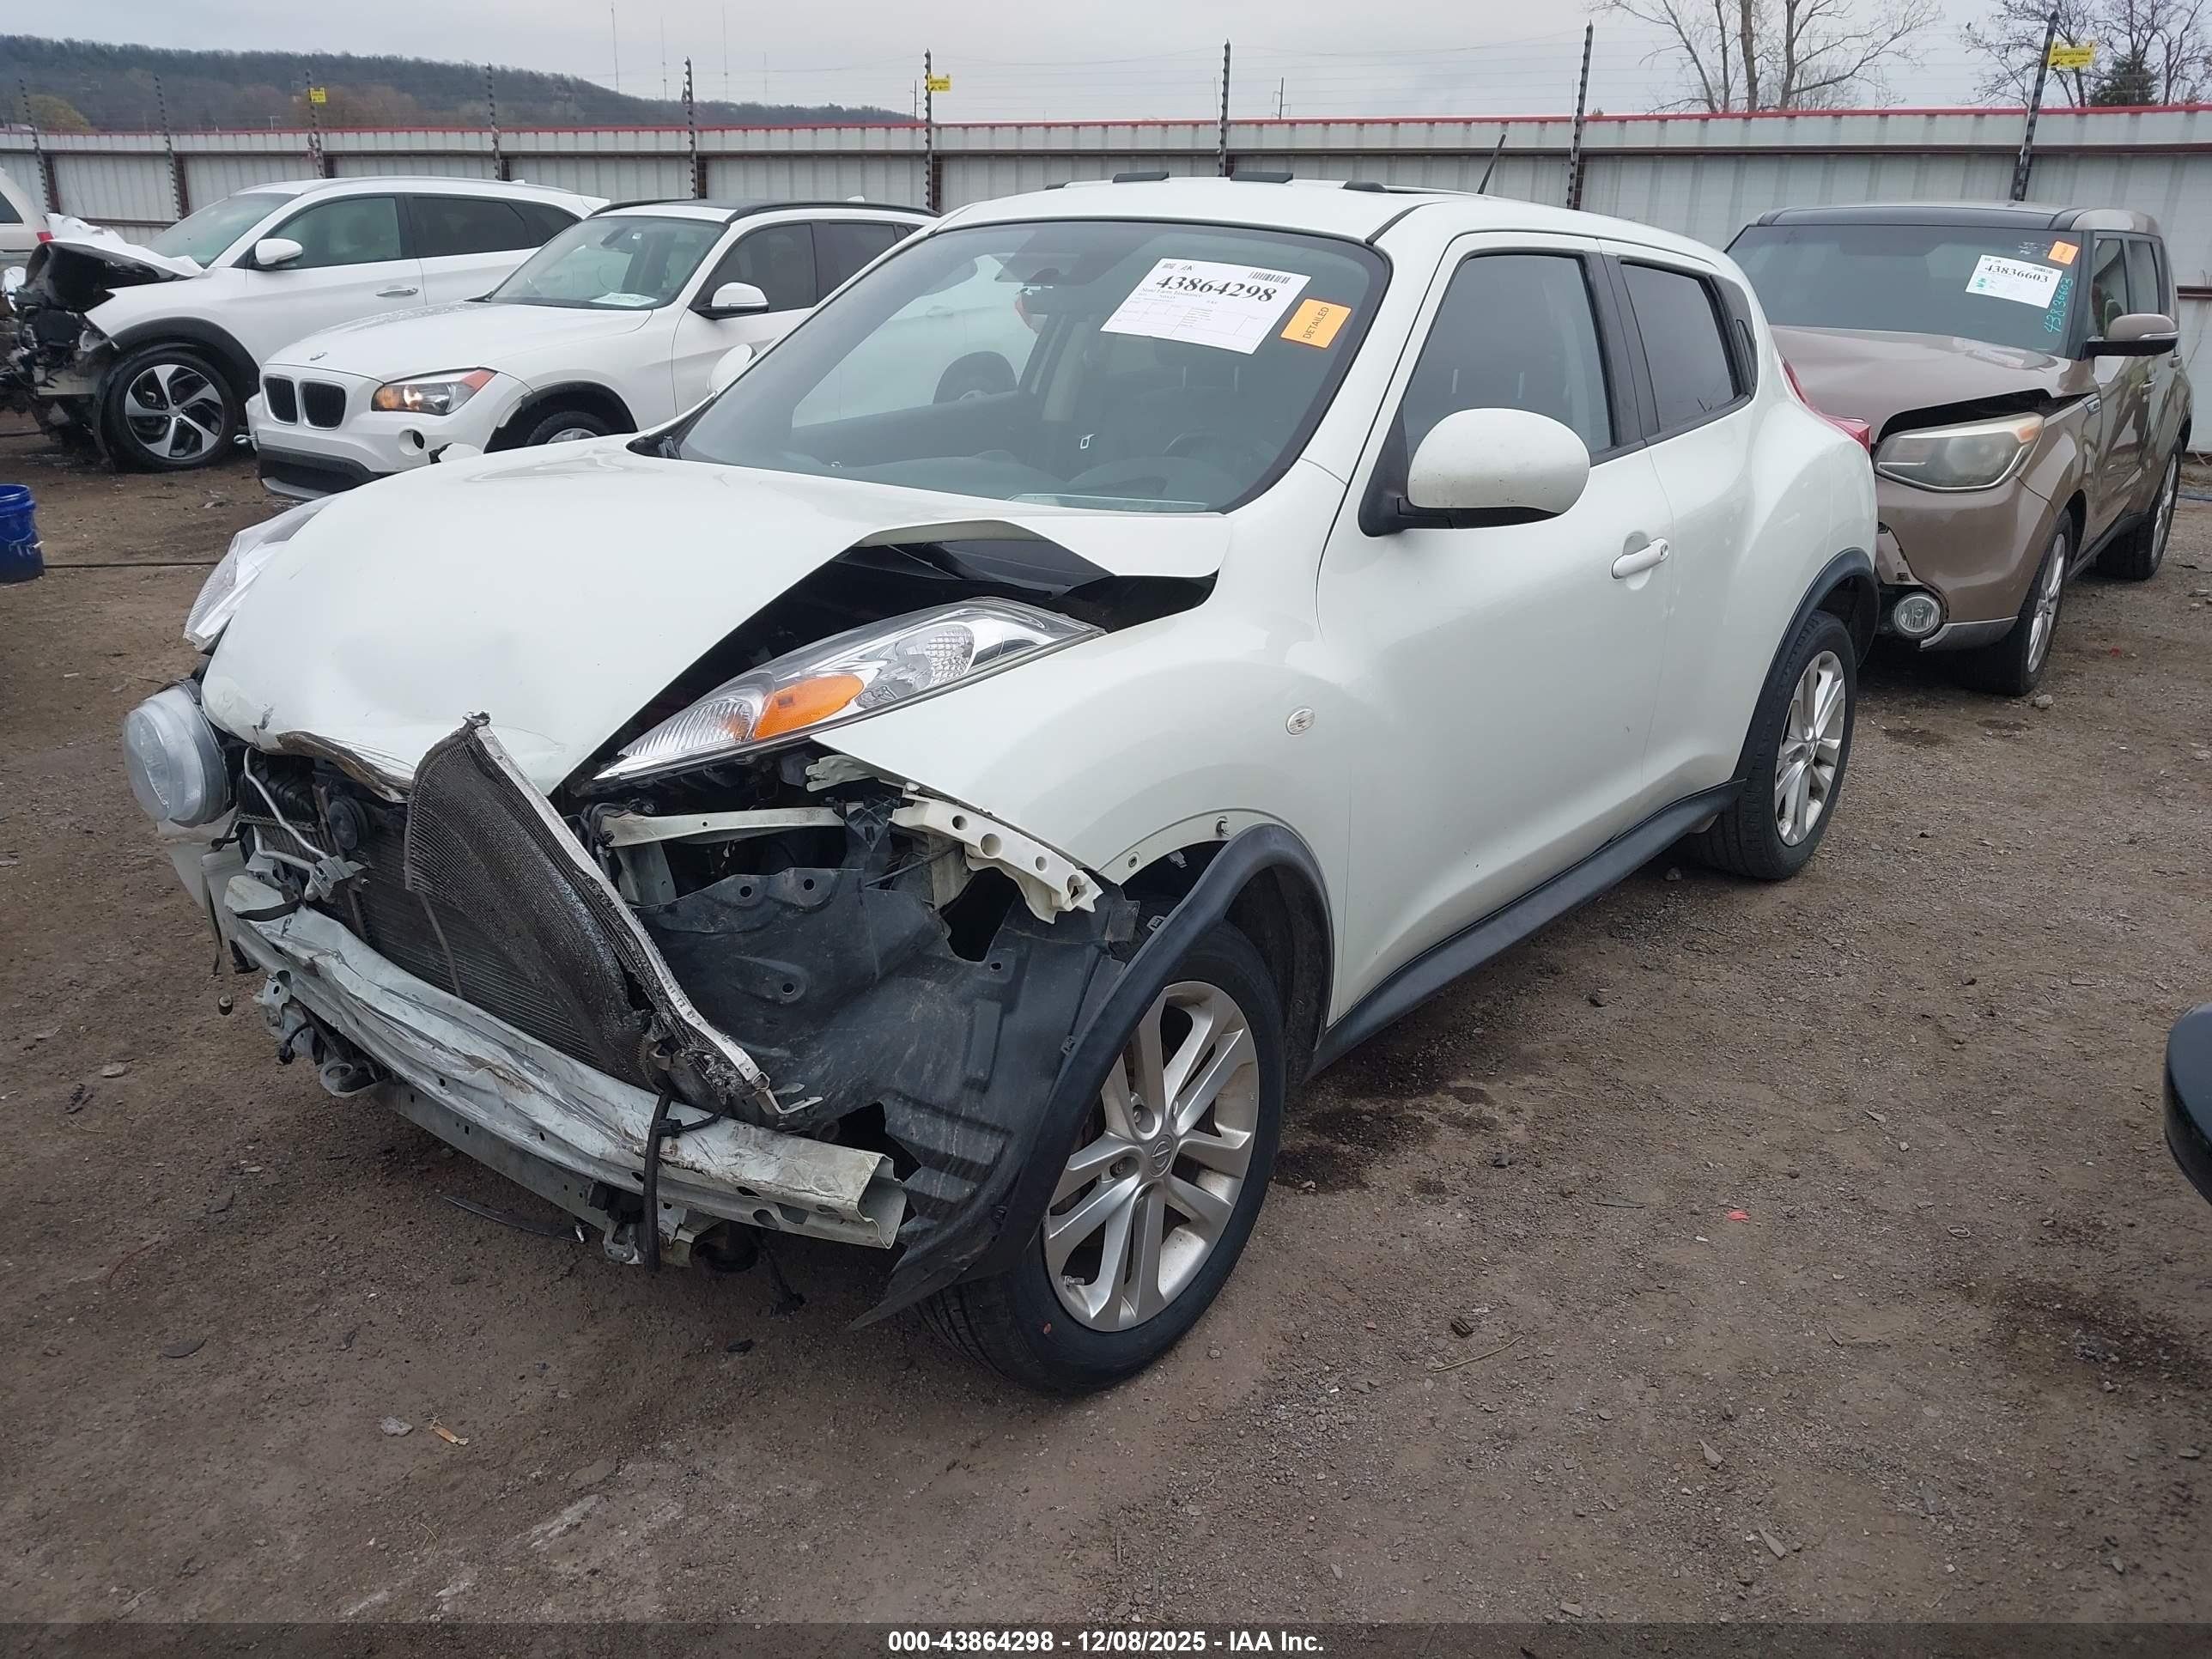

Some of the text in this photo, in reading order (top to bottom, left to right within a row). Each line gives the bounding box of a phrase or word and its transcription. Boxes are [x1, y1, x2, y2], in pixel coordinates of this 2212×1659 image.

[1984, 264, 2050, 283] 43836603
[1156, 275, 1278, 302] 43864298
[1303, 306, 1330, 339] DETAILED
